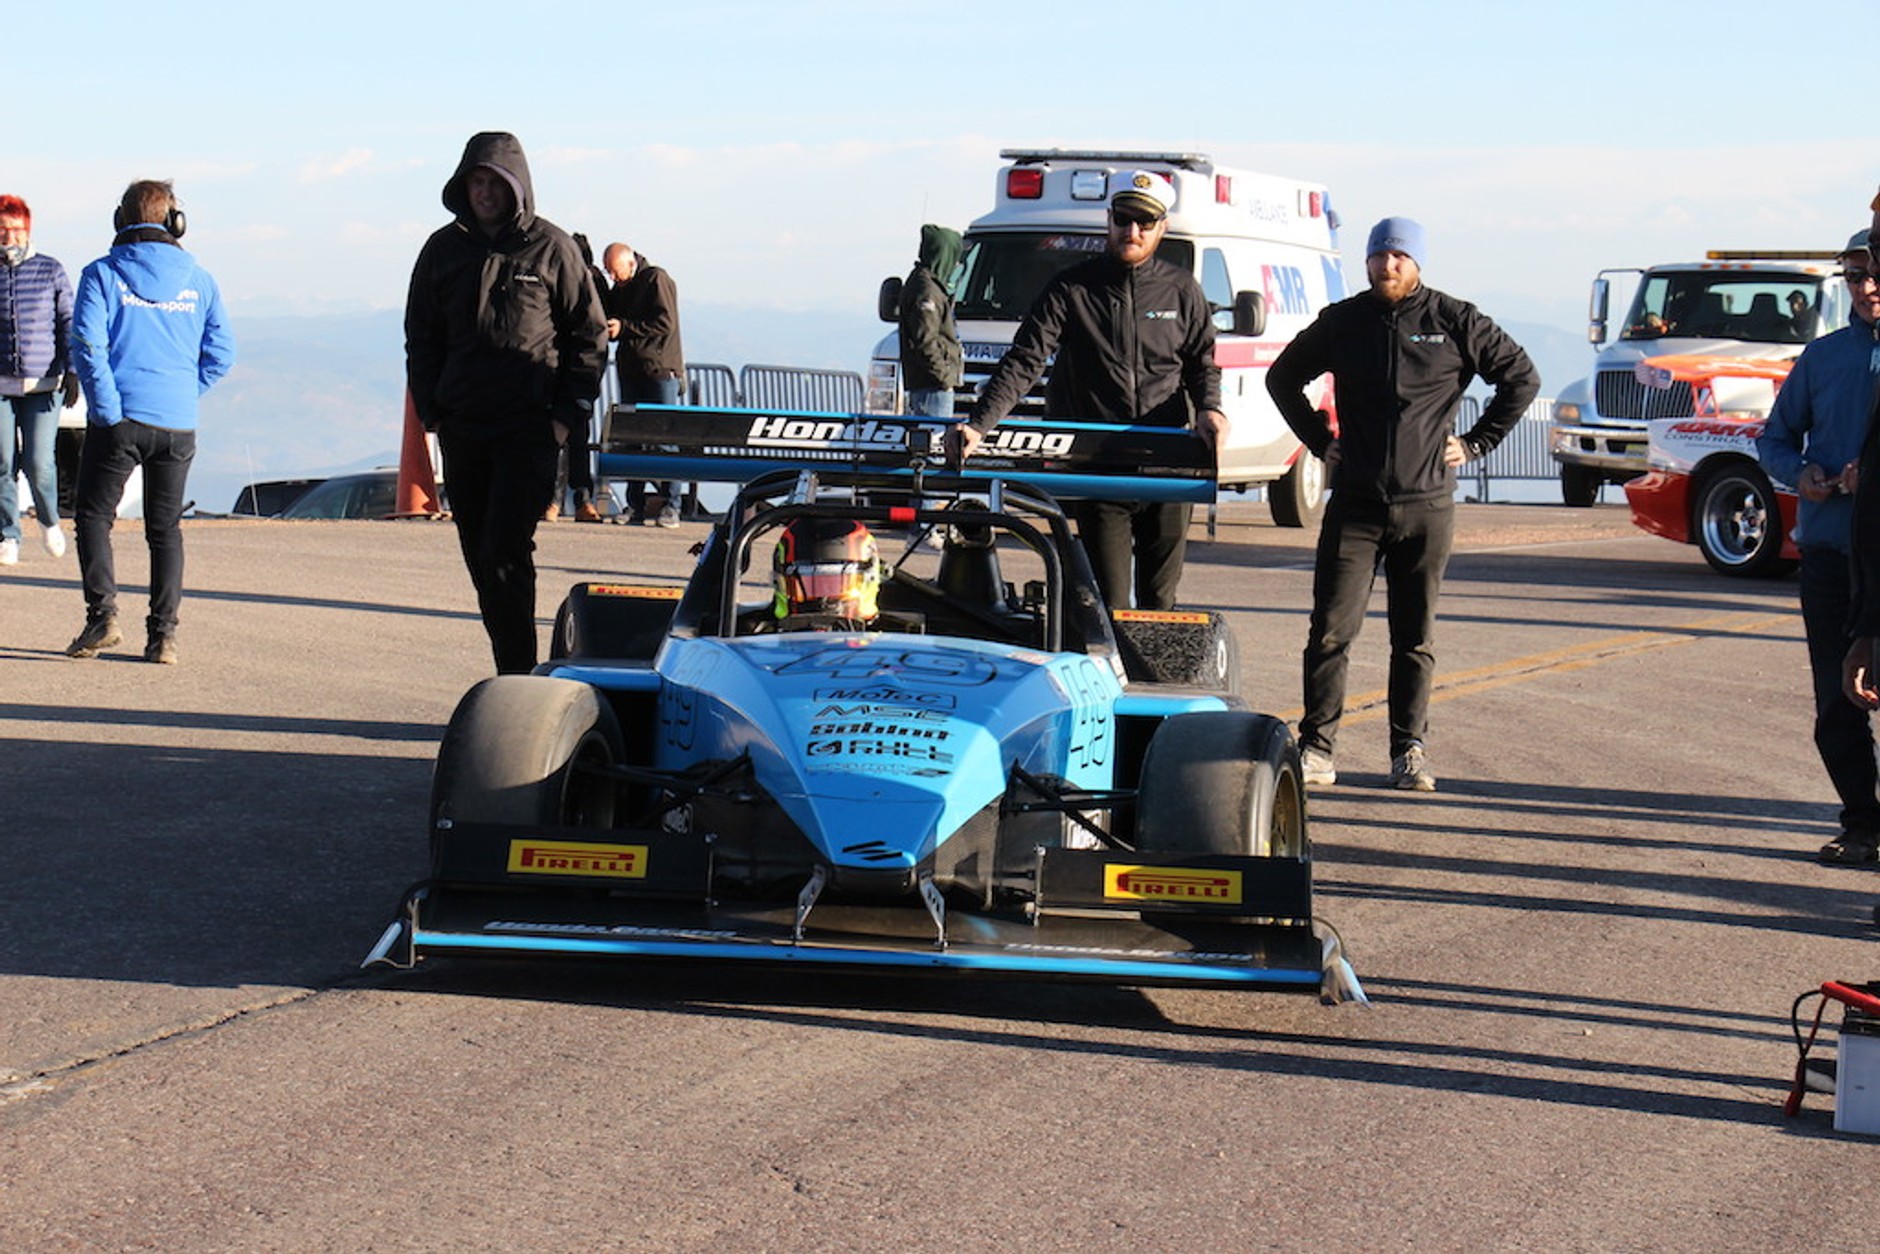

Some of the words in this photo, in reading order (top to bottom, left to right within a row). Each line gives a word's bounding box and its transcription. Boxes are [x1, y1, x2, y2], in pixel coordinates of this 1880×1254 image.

[1261, 264, 1310, 315] AMR
[747, 416, 906, 443] Honda
[1664, 434, 1755, 446] CONSTRUCT
[772, 648, 998, 687] 49
[828, 688, 942, 703] MoTeC
[521, 847, 635, 872] PIRELLI
[1116, 873, 1230, 898] PIRELLI
